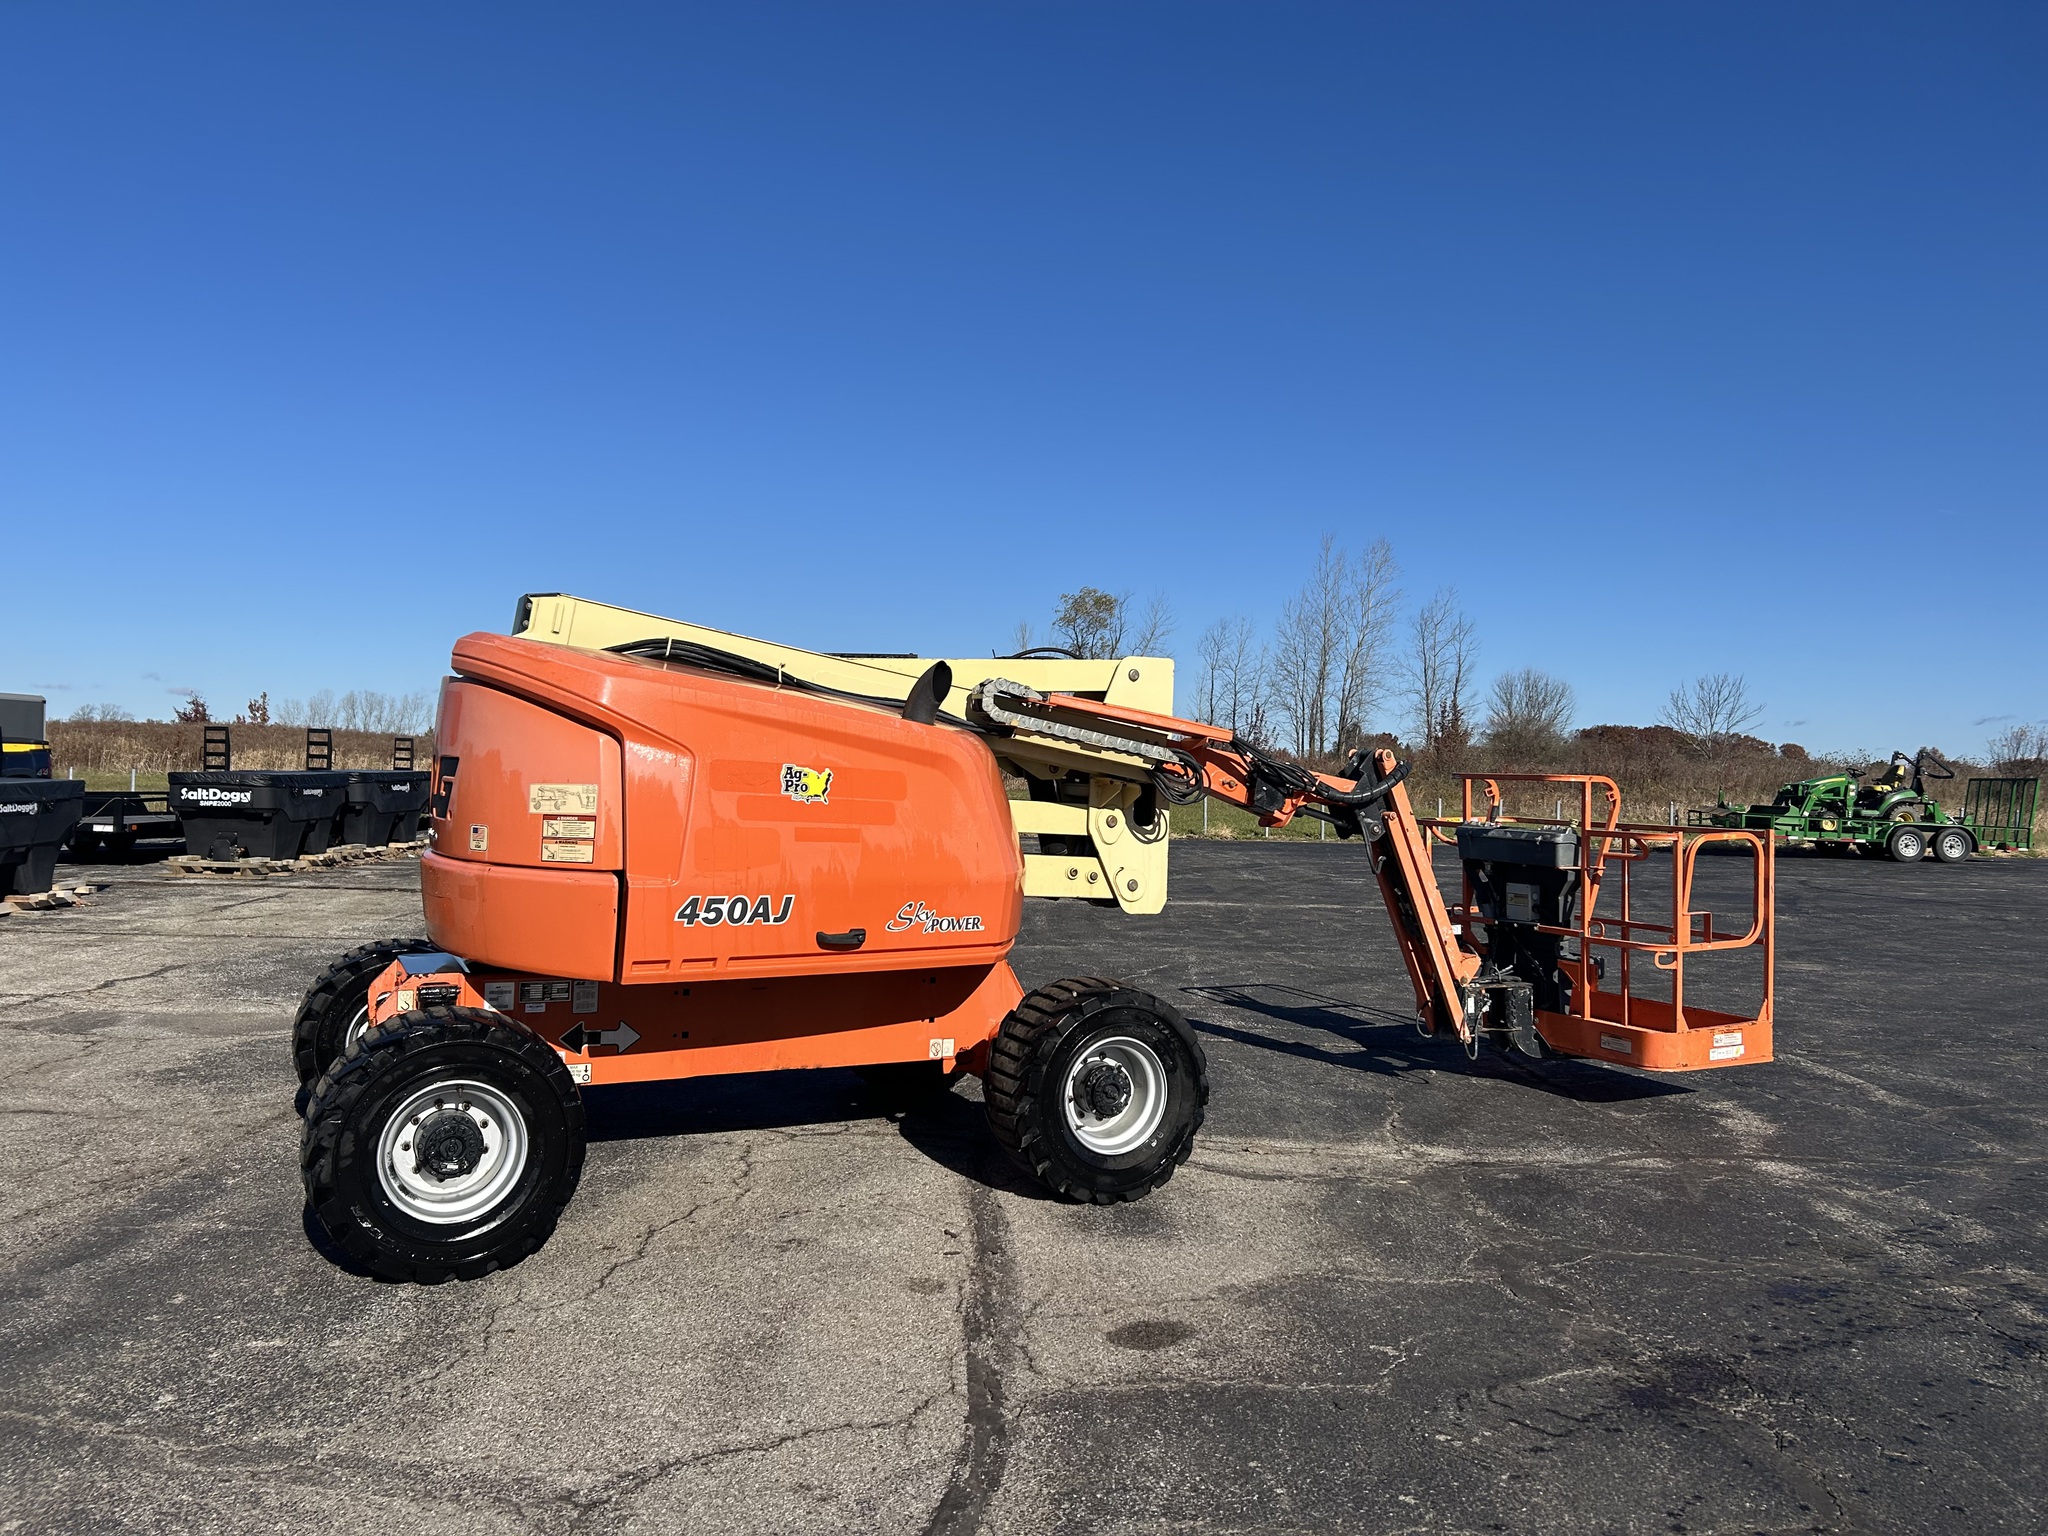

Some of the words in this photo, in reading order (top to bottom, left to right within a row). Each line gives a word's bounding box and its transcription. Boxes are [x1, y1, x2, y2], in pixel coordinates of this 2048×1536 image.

[784, 766, 808, 782] Ag-
[784, 779, 808, 793] Pro
[676, 896, 794, 926] 450AJ
[929, 916, 982, 932] POWER
